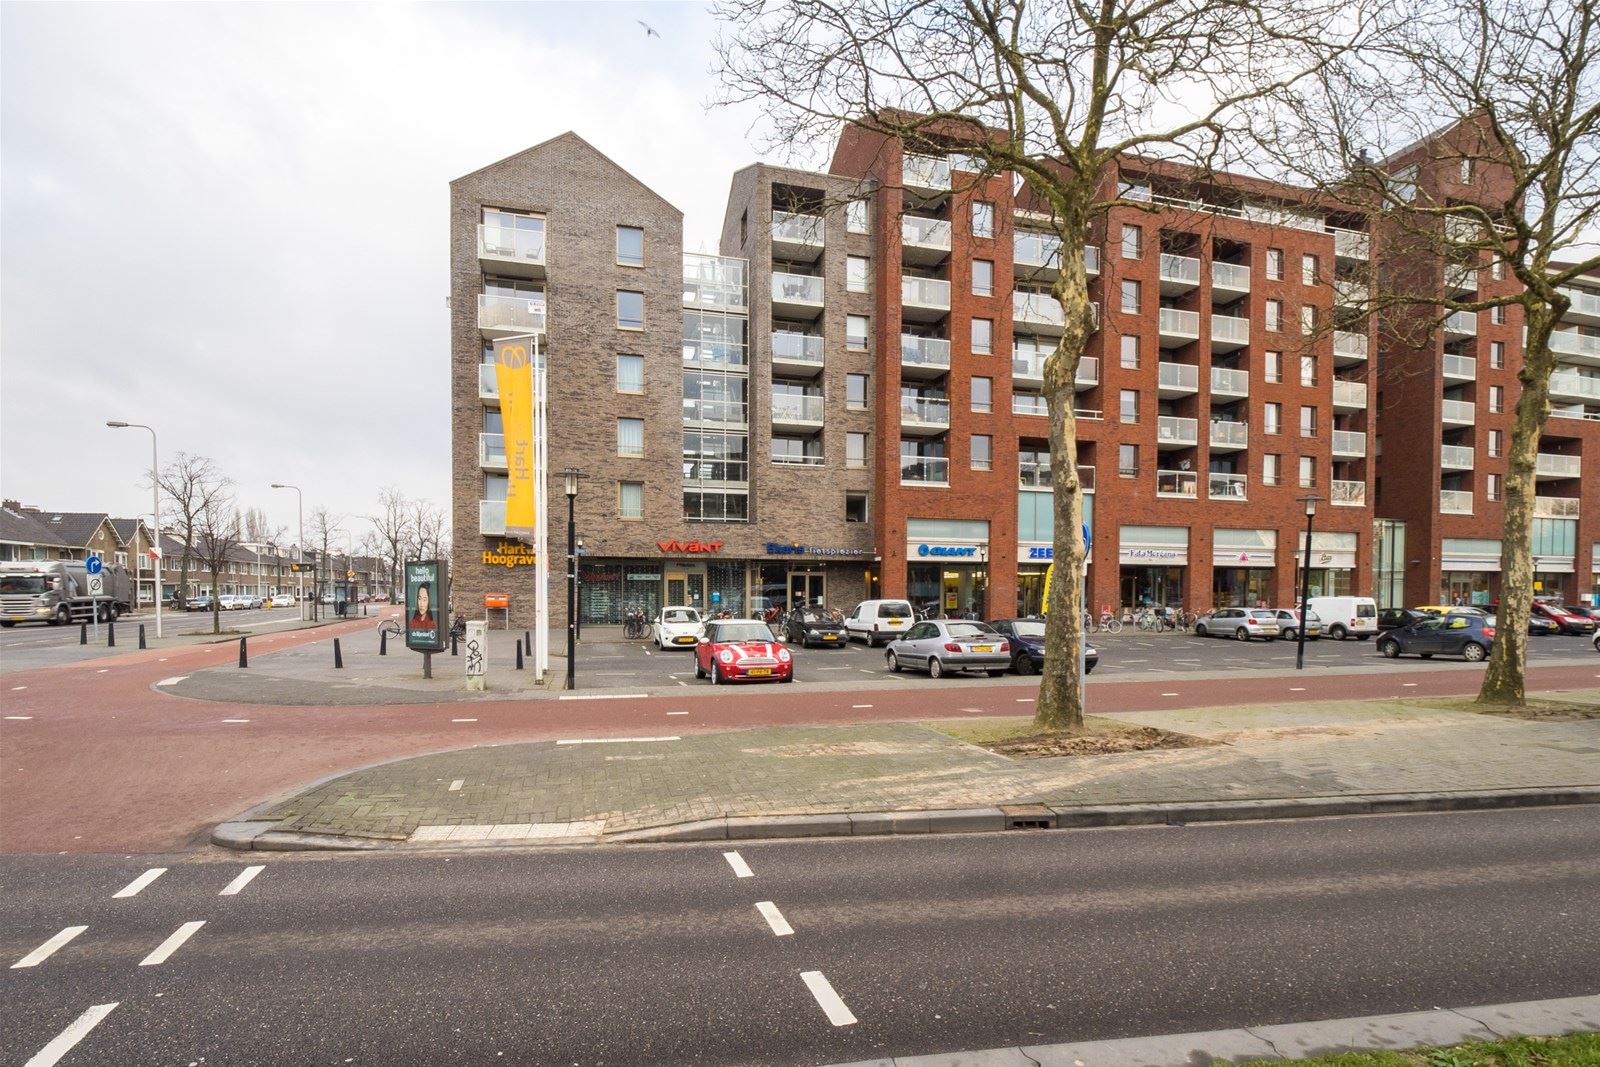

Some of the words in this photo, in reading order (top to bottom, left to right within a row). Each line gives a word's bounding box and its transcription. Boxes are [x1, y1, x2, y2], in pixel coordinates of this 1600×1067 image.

[499, 542, 526, 554] Hart
[930, 547, 977, 556] GIANT
[415, 567, 429, 575] hello
[411, 574, 434, 582] beautiful
